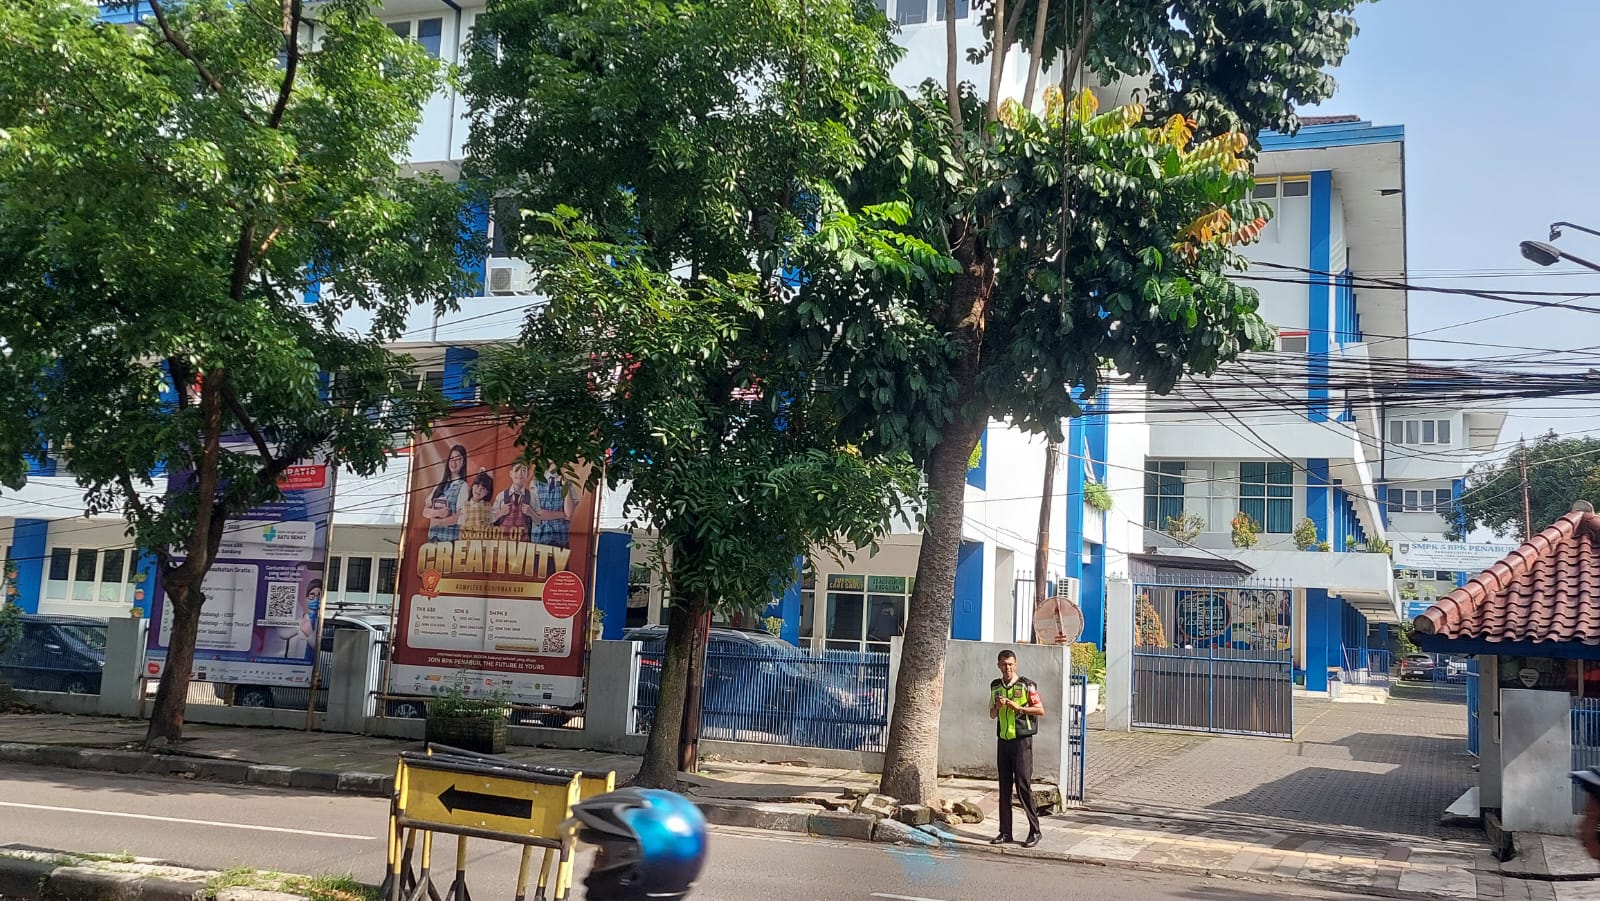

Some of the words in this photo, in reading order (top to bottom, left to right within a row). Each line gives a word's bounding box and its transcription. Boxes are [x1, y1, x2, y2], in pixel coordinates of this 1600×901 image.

[462, 526, 504, 540] SCHOOL
[509, 526, 525, 540] OF
[417, 539, 572, 579] CREATIVITY
